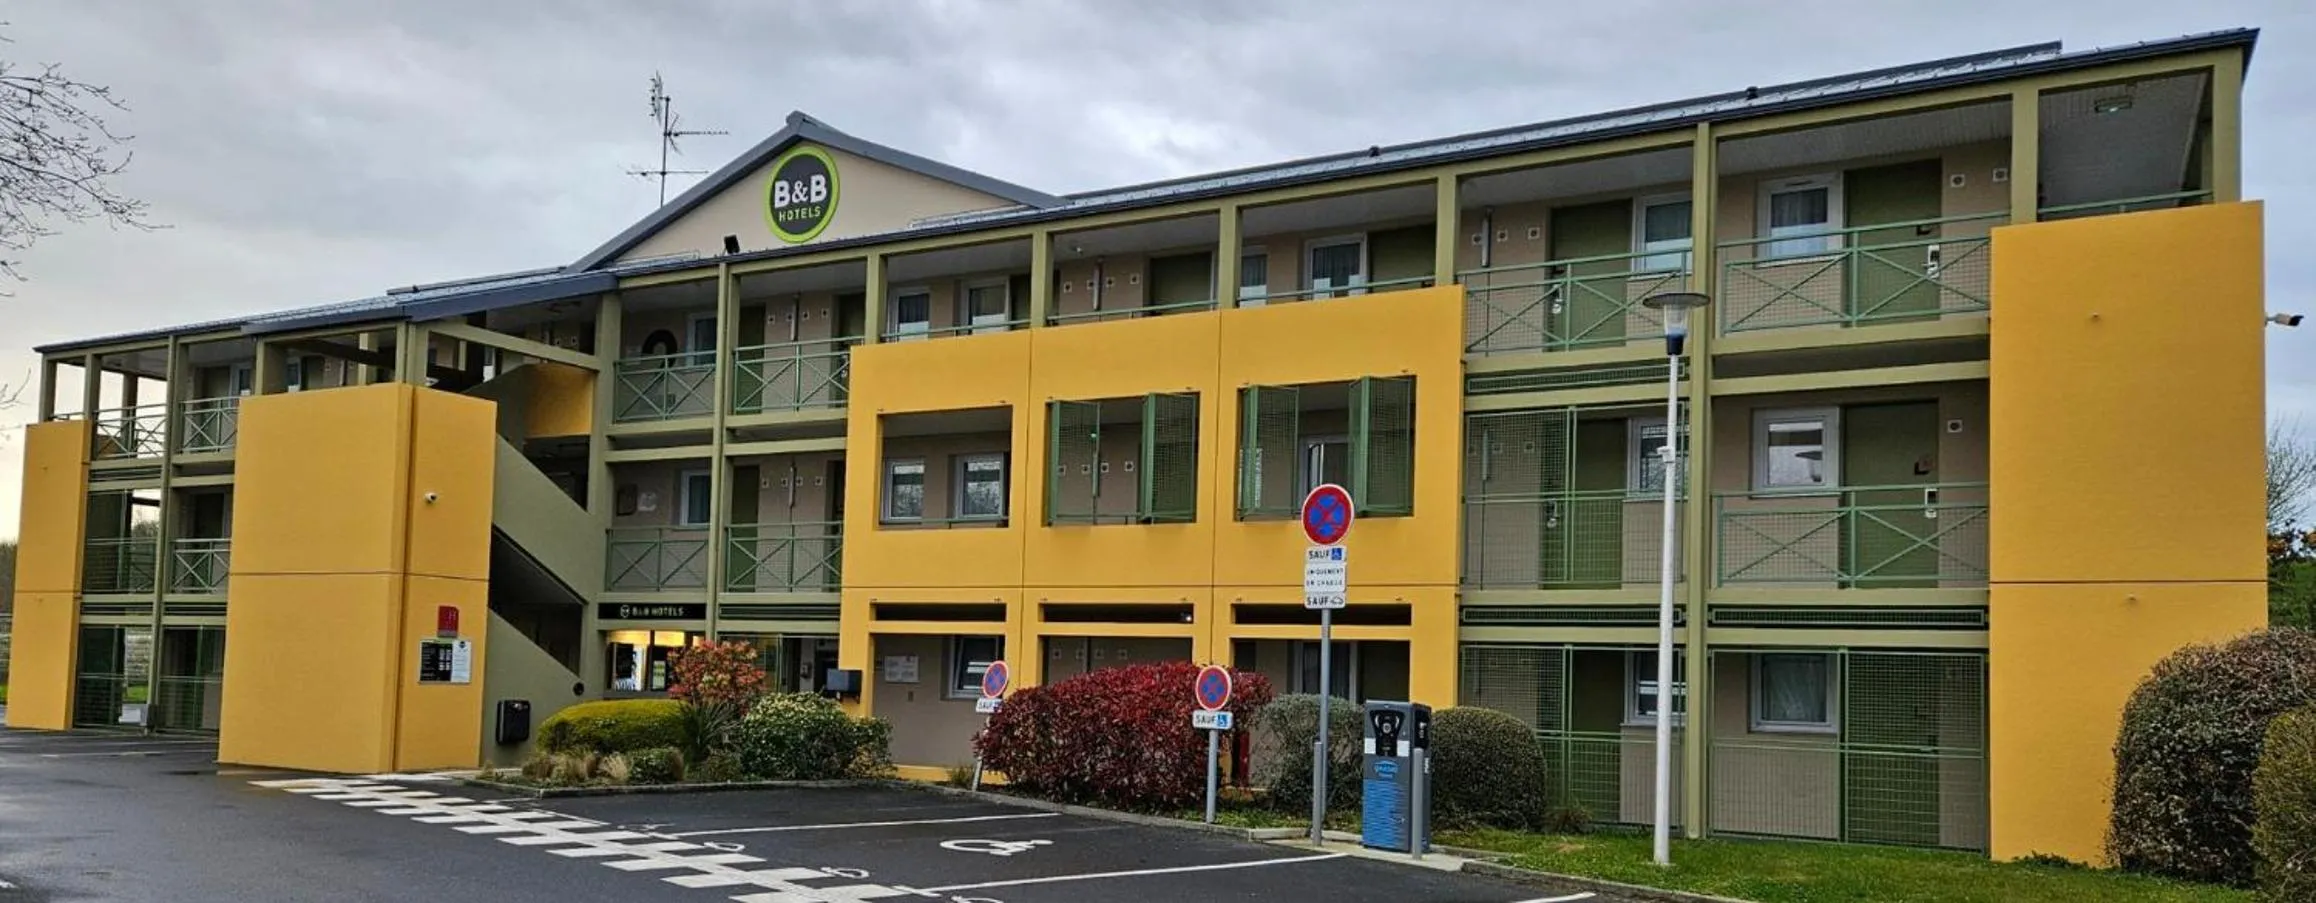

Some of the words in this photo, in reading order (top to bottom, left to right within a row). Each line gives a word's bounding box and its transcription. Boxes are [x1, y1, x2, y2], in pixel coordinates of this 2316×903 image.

[774, 174, 827, 209] B&B
[779, 206, 821, 222] HOTELS
[1309, 550, 1329, 560] SAUF
[1307, 596, 1329, 606] SAUF
[651, 606, 684, 617] HOTELS
[1196, 714, 1216, 724] SAUF
